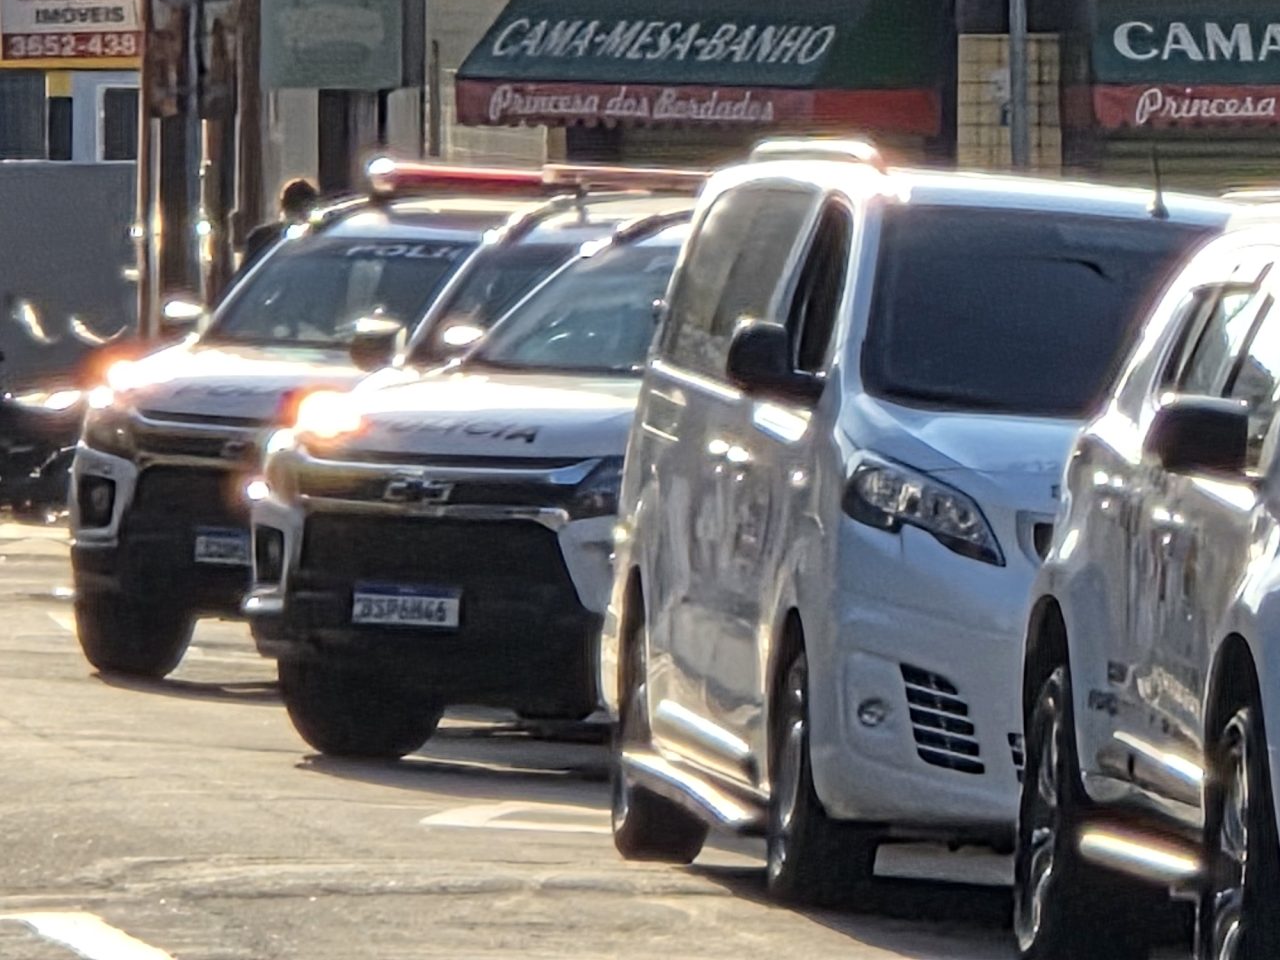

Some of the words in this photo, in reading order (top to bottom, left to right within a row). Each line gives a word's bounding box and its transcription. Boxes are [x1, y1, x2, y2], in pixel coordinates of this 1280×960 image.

[489, 84, 598, 120] Princesa
[605, 86, 650, 118] dos
[653, 87, 774, 121] Bordados
[1135, 88, 1276, 125] Princesa
